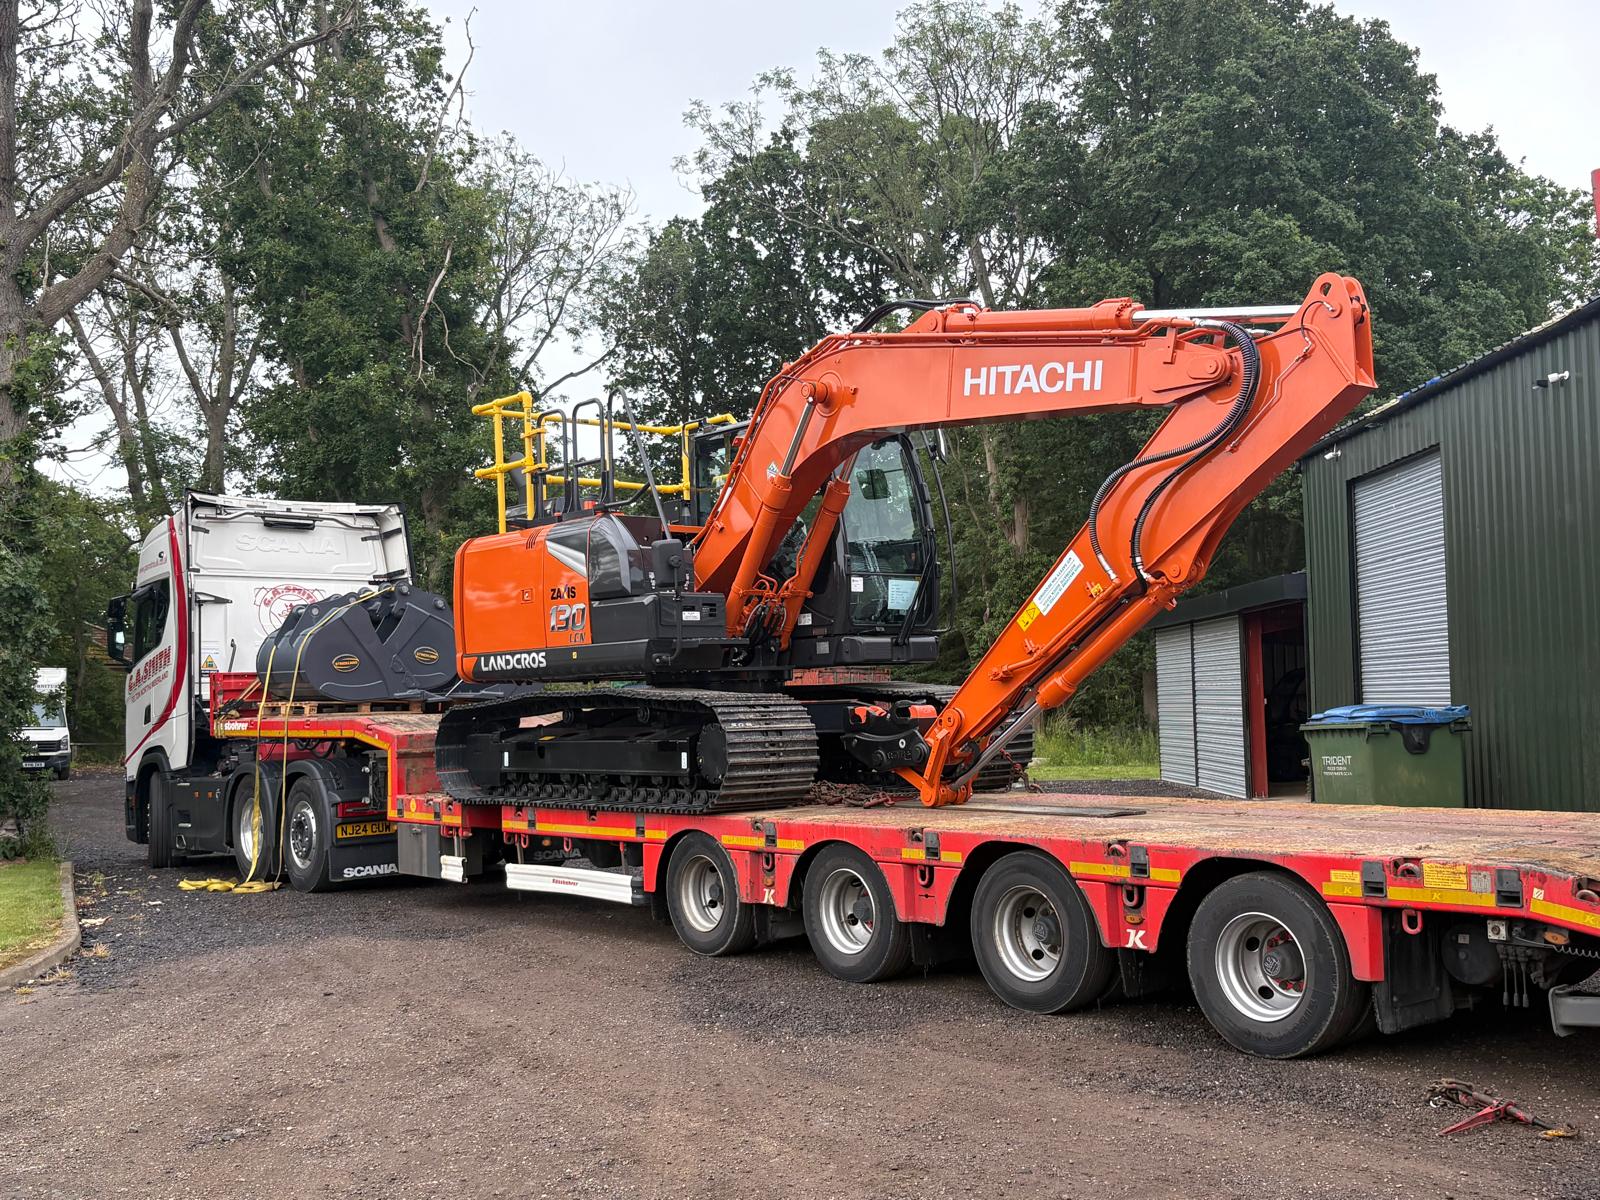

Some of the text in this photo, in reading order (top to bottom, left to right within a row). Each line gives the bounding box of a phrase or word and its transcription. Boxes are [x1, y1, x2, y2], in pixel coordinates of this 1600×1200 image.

[963, 360, 1103, 396] HITACHI
[550, 603, 586, 632] 130
[569, 632, 586, 643] LCN
[480, 652, 547, 672] LANDCROS
[1321, 755, 1353, 766] TRIDENT
[340, 824, 368, 837] NJ24
[343, 863, 399, 878] SCANIA
